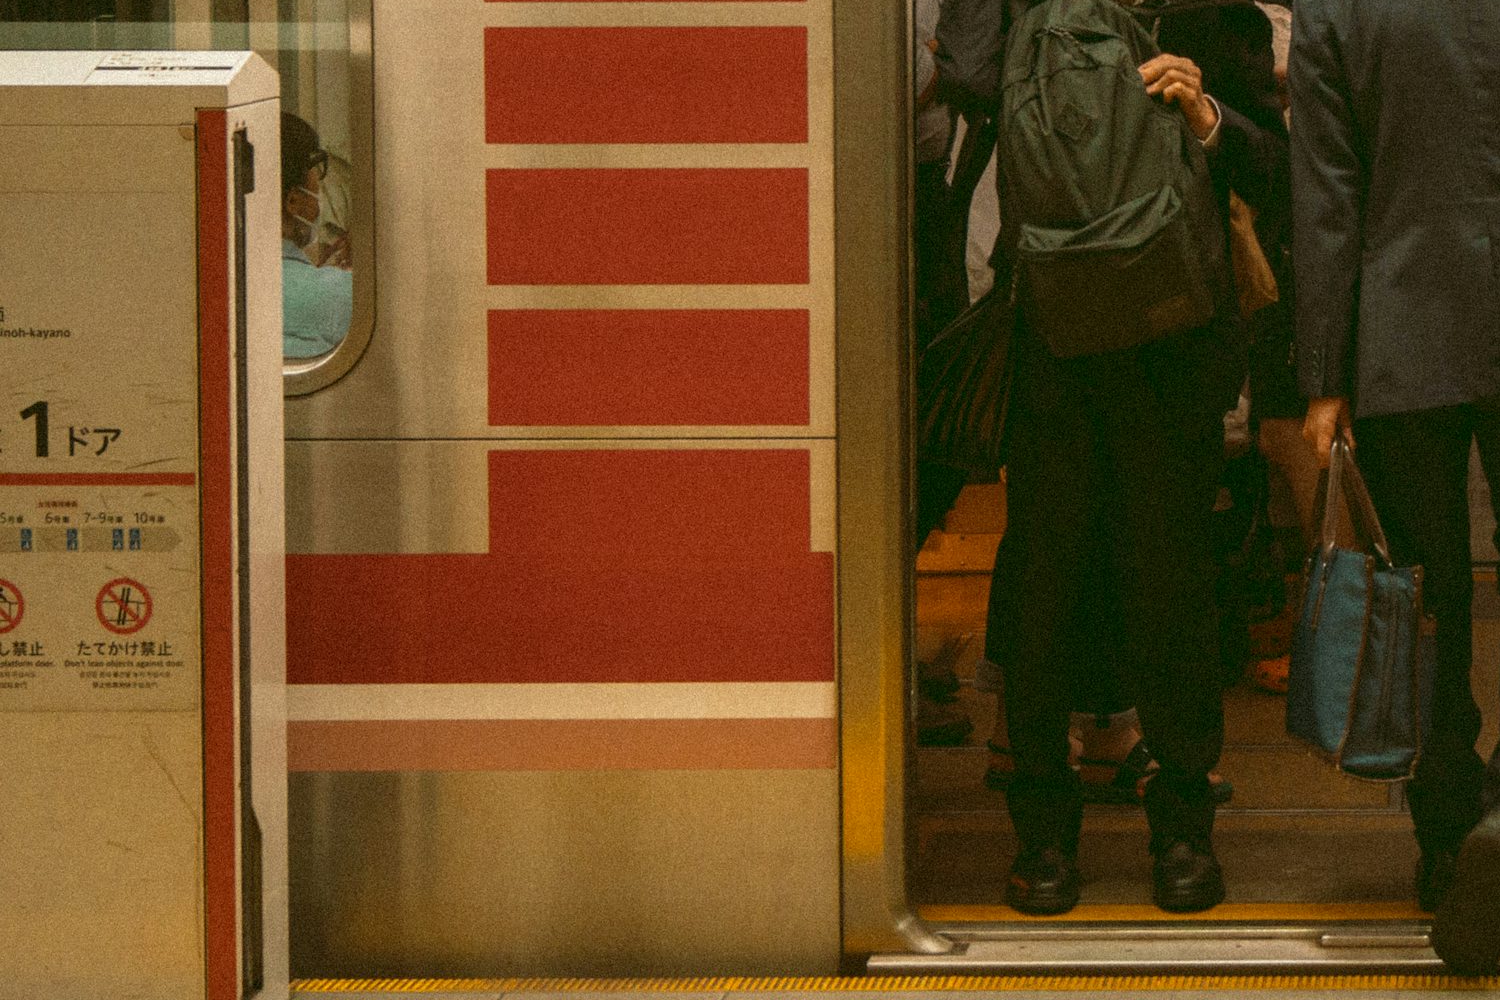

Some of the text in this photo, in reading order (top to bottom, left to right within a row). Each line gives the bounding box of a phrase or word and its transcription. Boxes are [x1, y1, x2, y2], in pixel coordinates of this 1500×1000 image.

[77, 641, 172, 656] たてかけ禁止
